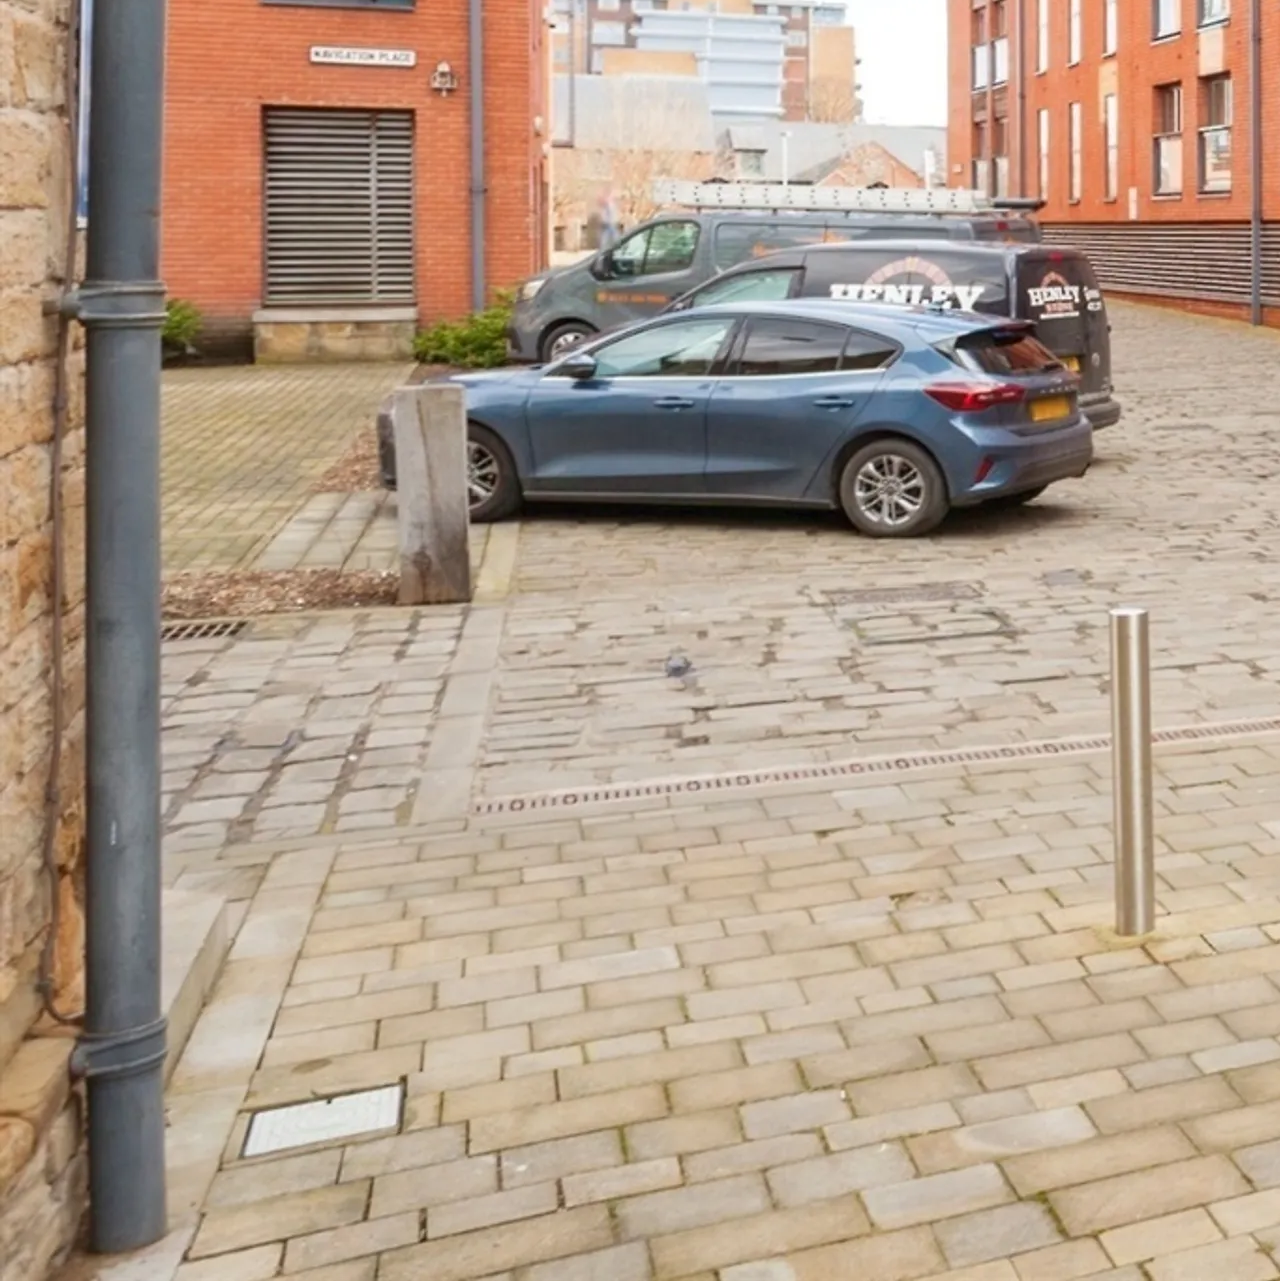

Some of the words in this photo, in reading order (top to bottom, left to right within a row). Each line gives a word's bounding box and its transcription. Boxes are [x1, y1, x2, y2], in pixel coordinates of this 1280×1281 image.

[315, 49, 375, 59] NAVIGATION
[379, 51, 411, 61] PLACE
[829, 283, 985, 312] HENLEY
[1027, 285, 1080, 307] HENLEY
